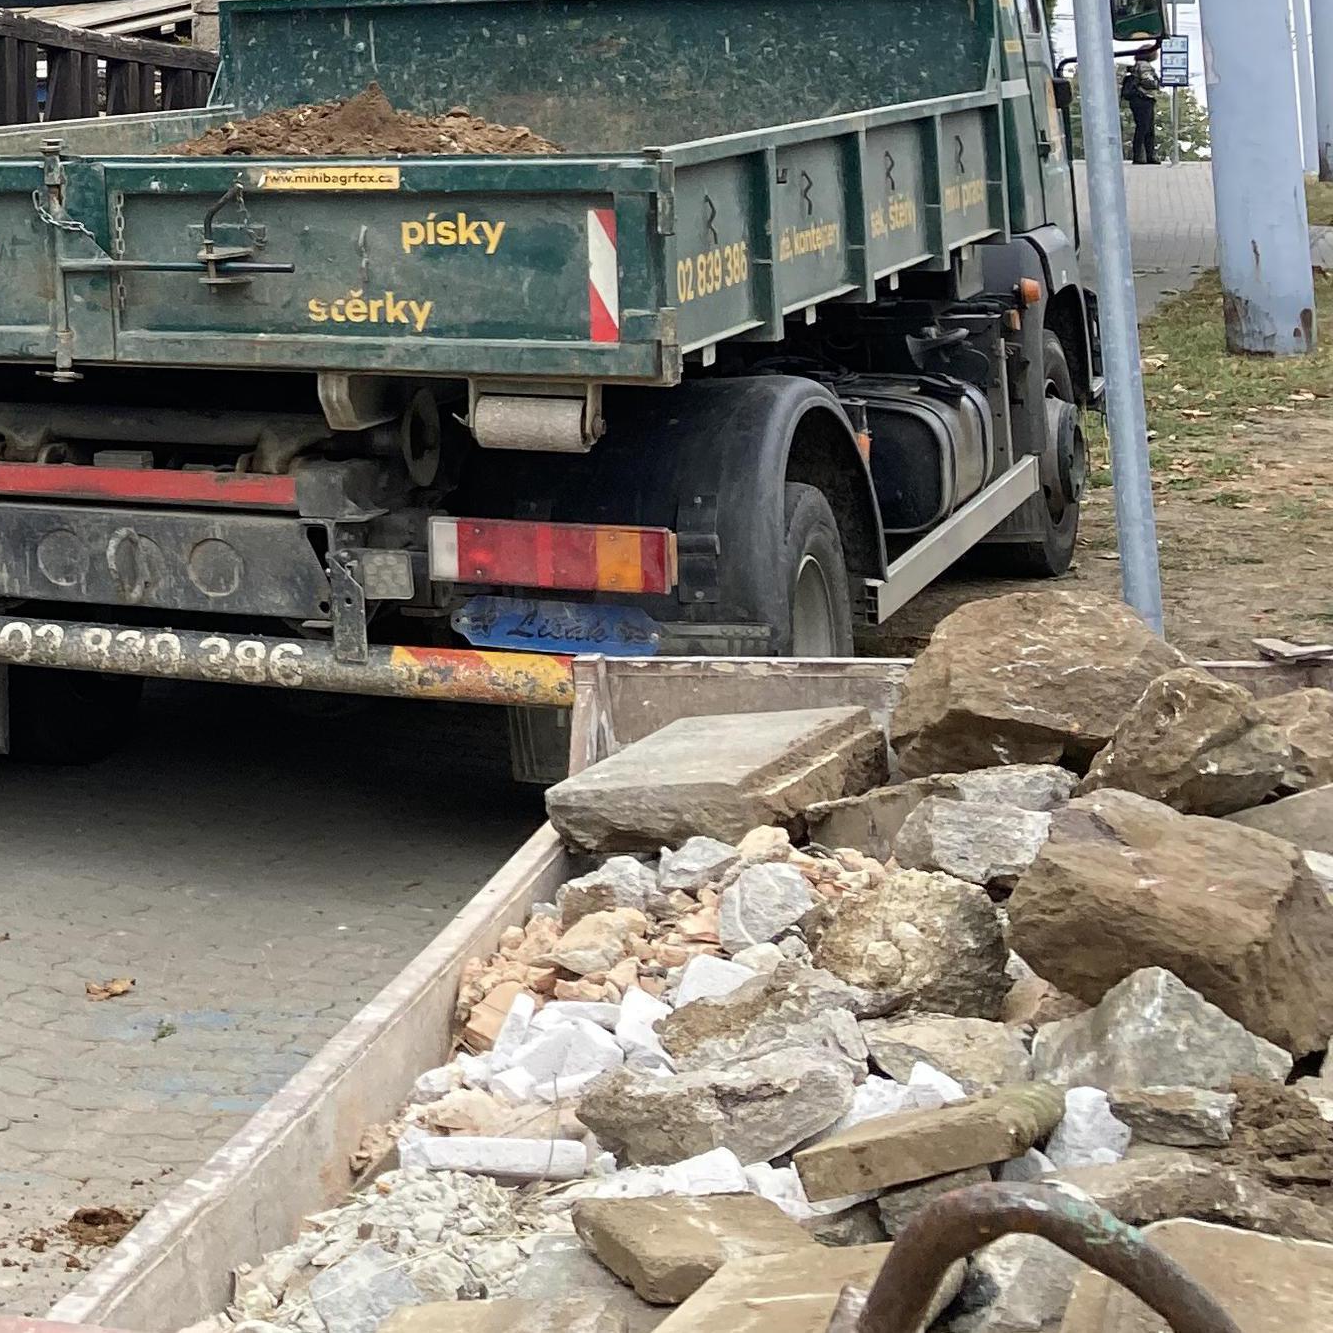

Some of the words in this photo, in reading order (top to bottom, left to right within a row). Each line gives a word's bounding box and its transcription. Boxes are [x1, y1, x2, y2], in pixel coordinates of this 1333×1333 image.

[401, 212, 505, 255] písky
[697, 249, 722, 297] 839
[724, 240, 749, 287] 386
